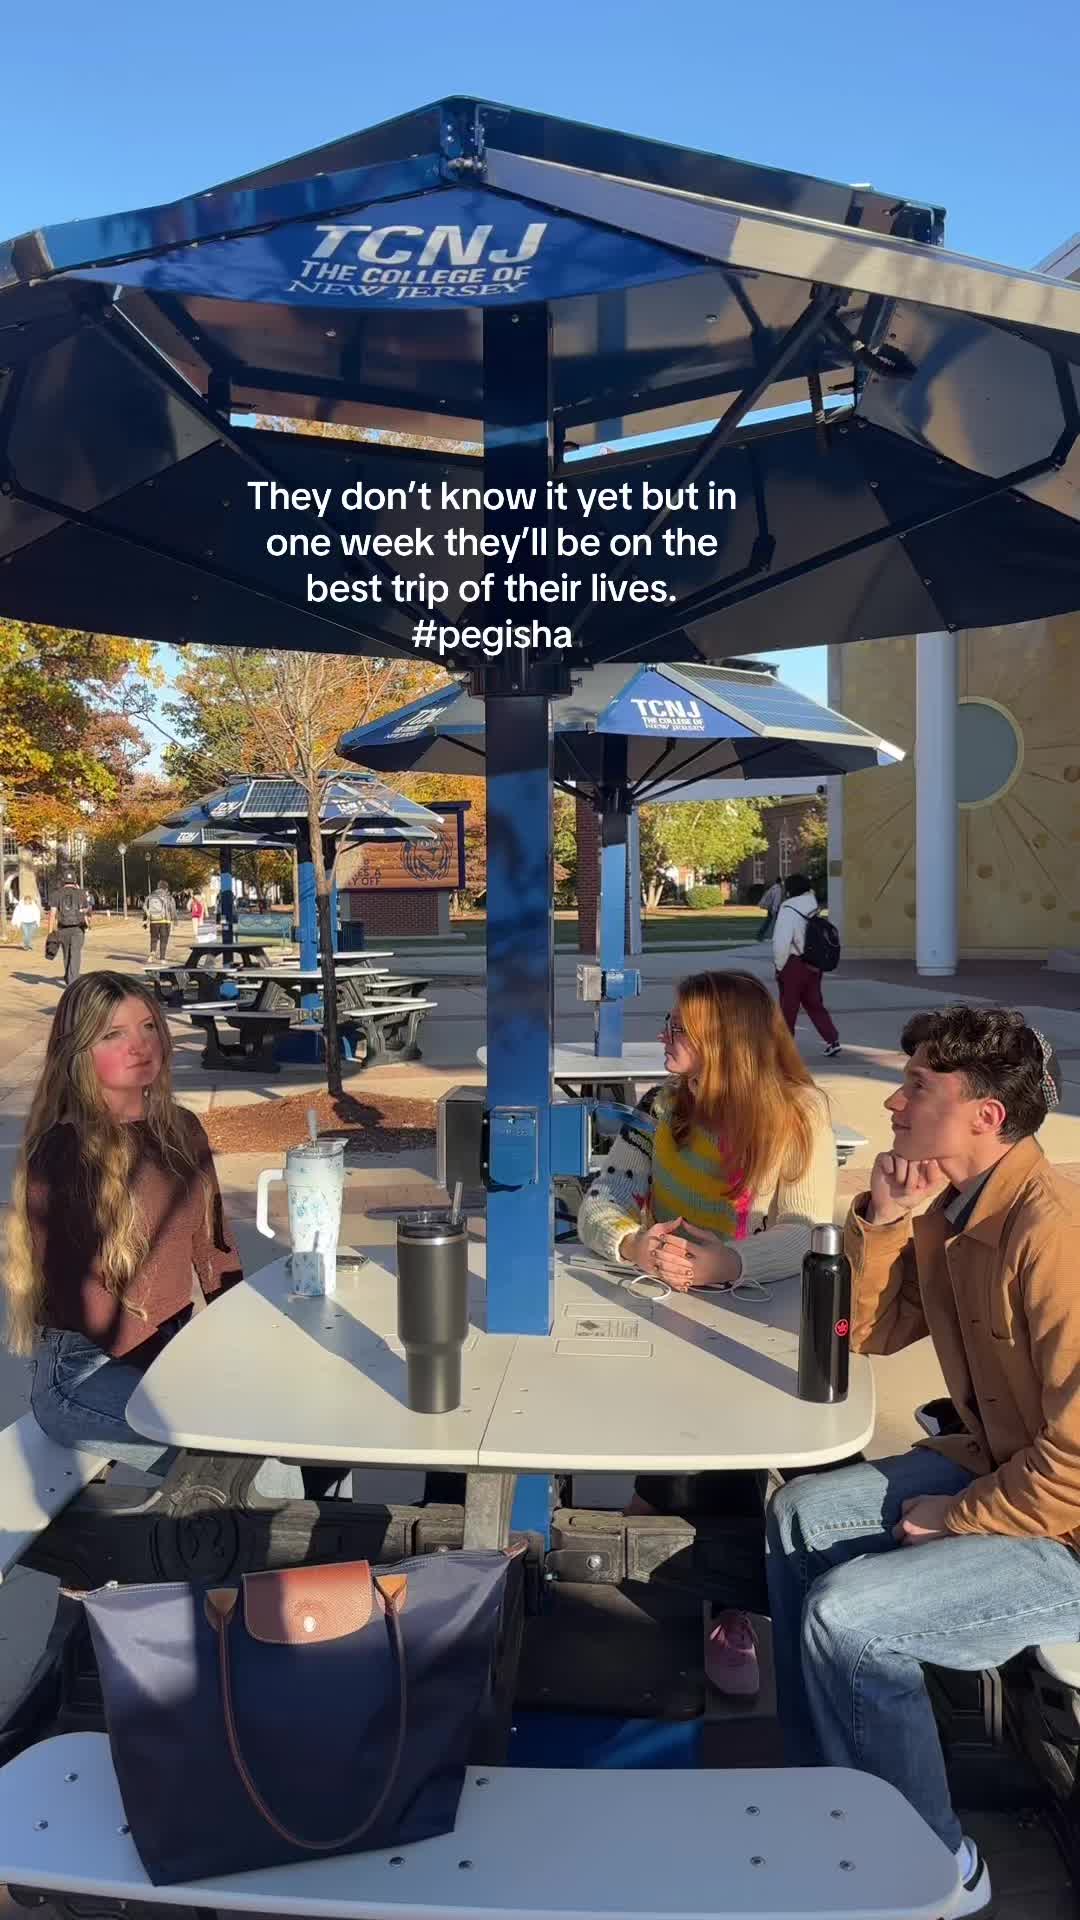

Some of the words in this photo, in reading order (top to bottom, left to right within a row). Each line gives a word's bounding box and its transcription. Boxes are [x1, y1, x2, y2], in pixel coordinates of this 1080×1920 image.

[310, 222, 548, 266] TCNJ
[301, 260, 358, 282] THE
[361, 267, 488, 284] COLLEGE
[491, 266, 533, 282] OF
[286, 279, 390, 297] NEW
[389, 281, 530, 300] JERSEY
[630, 698, 701, 718] TCNJ
